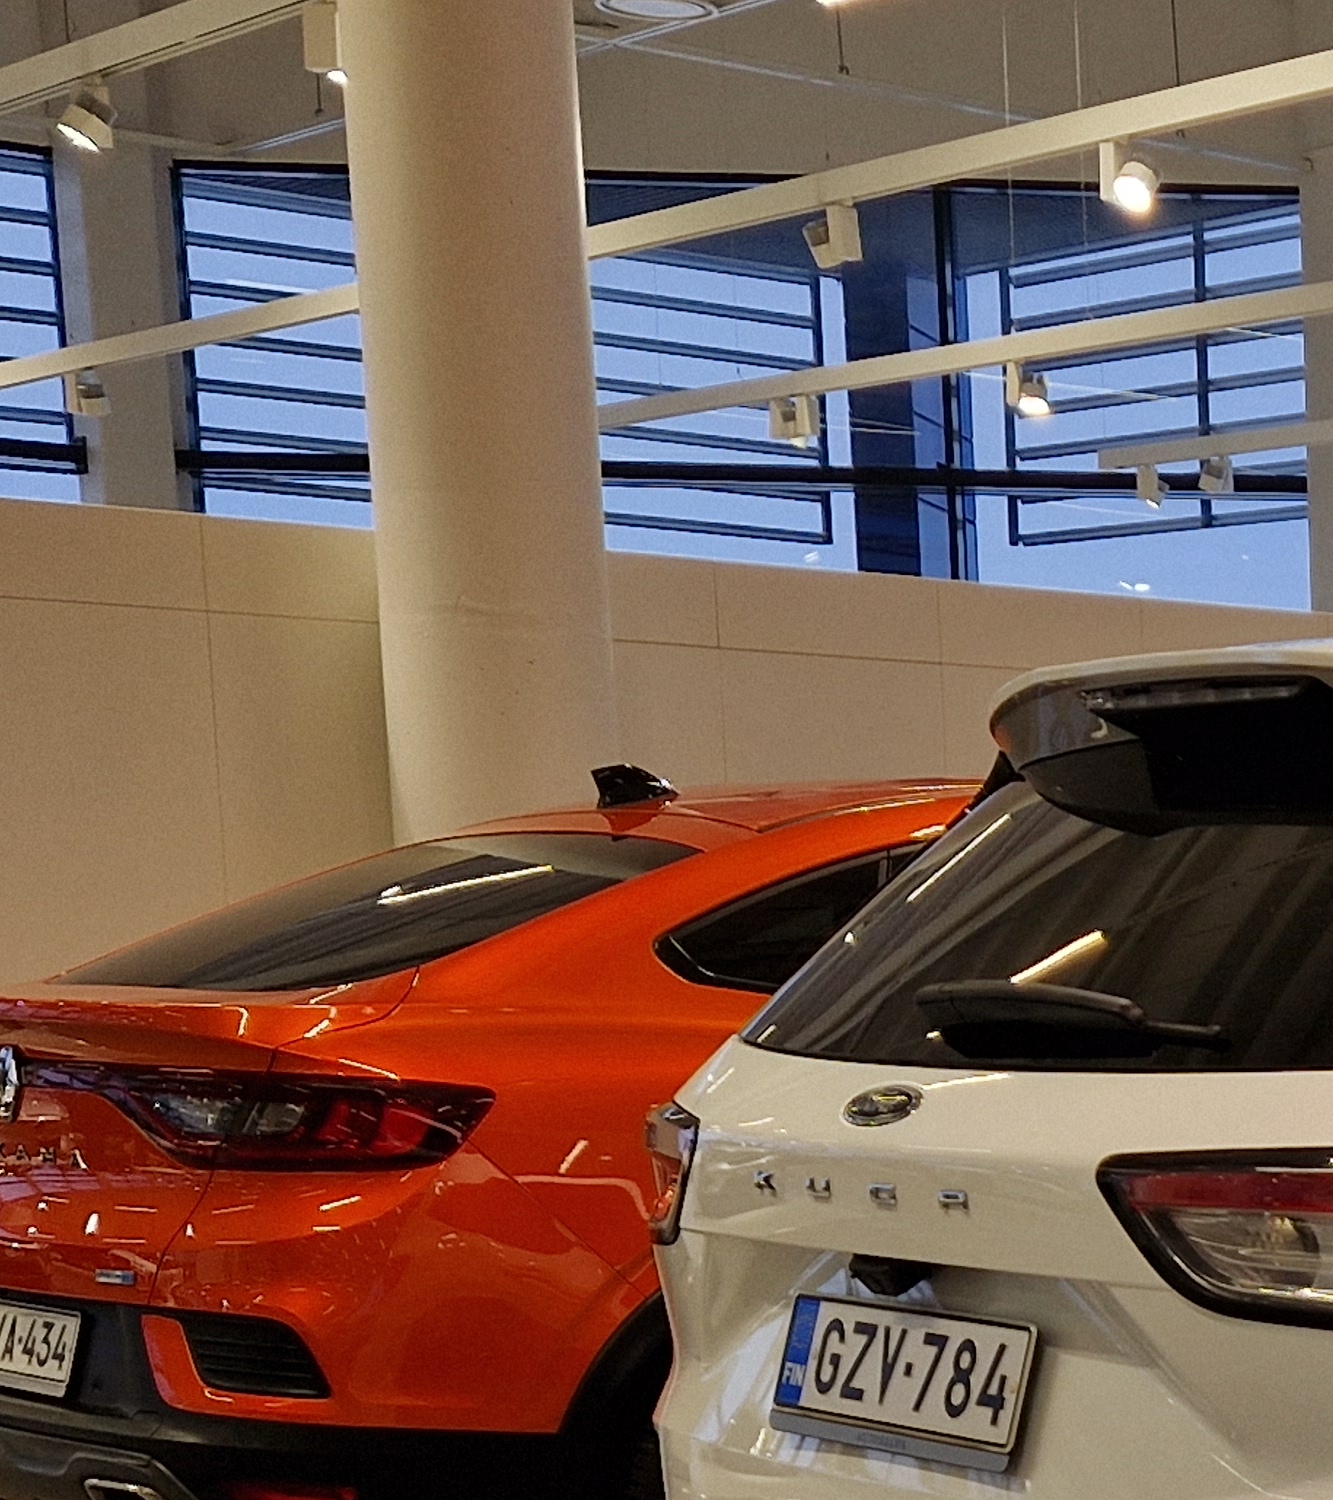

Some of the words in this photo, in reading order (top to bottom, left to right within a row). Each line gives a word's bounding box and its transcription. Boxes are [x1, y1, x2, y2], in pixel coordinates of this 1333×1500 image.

[754, 1170, 969, 1210] KUGA
[782, 1361, 807, 1386] FIN
[814, 1317, 1008, 1426] GZV-784
